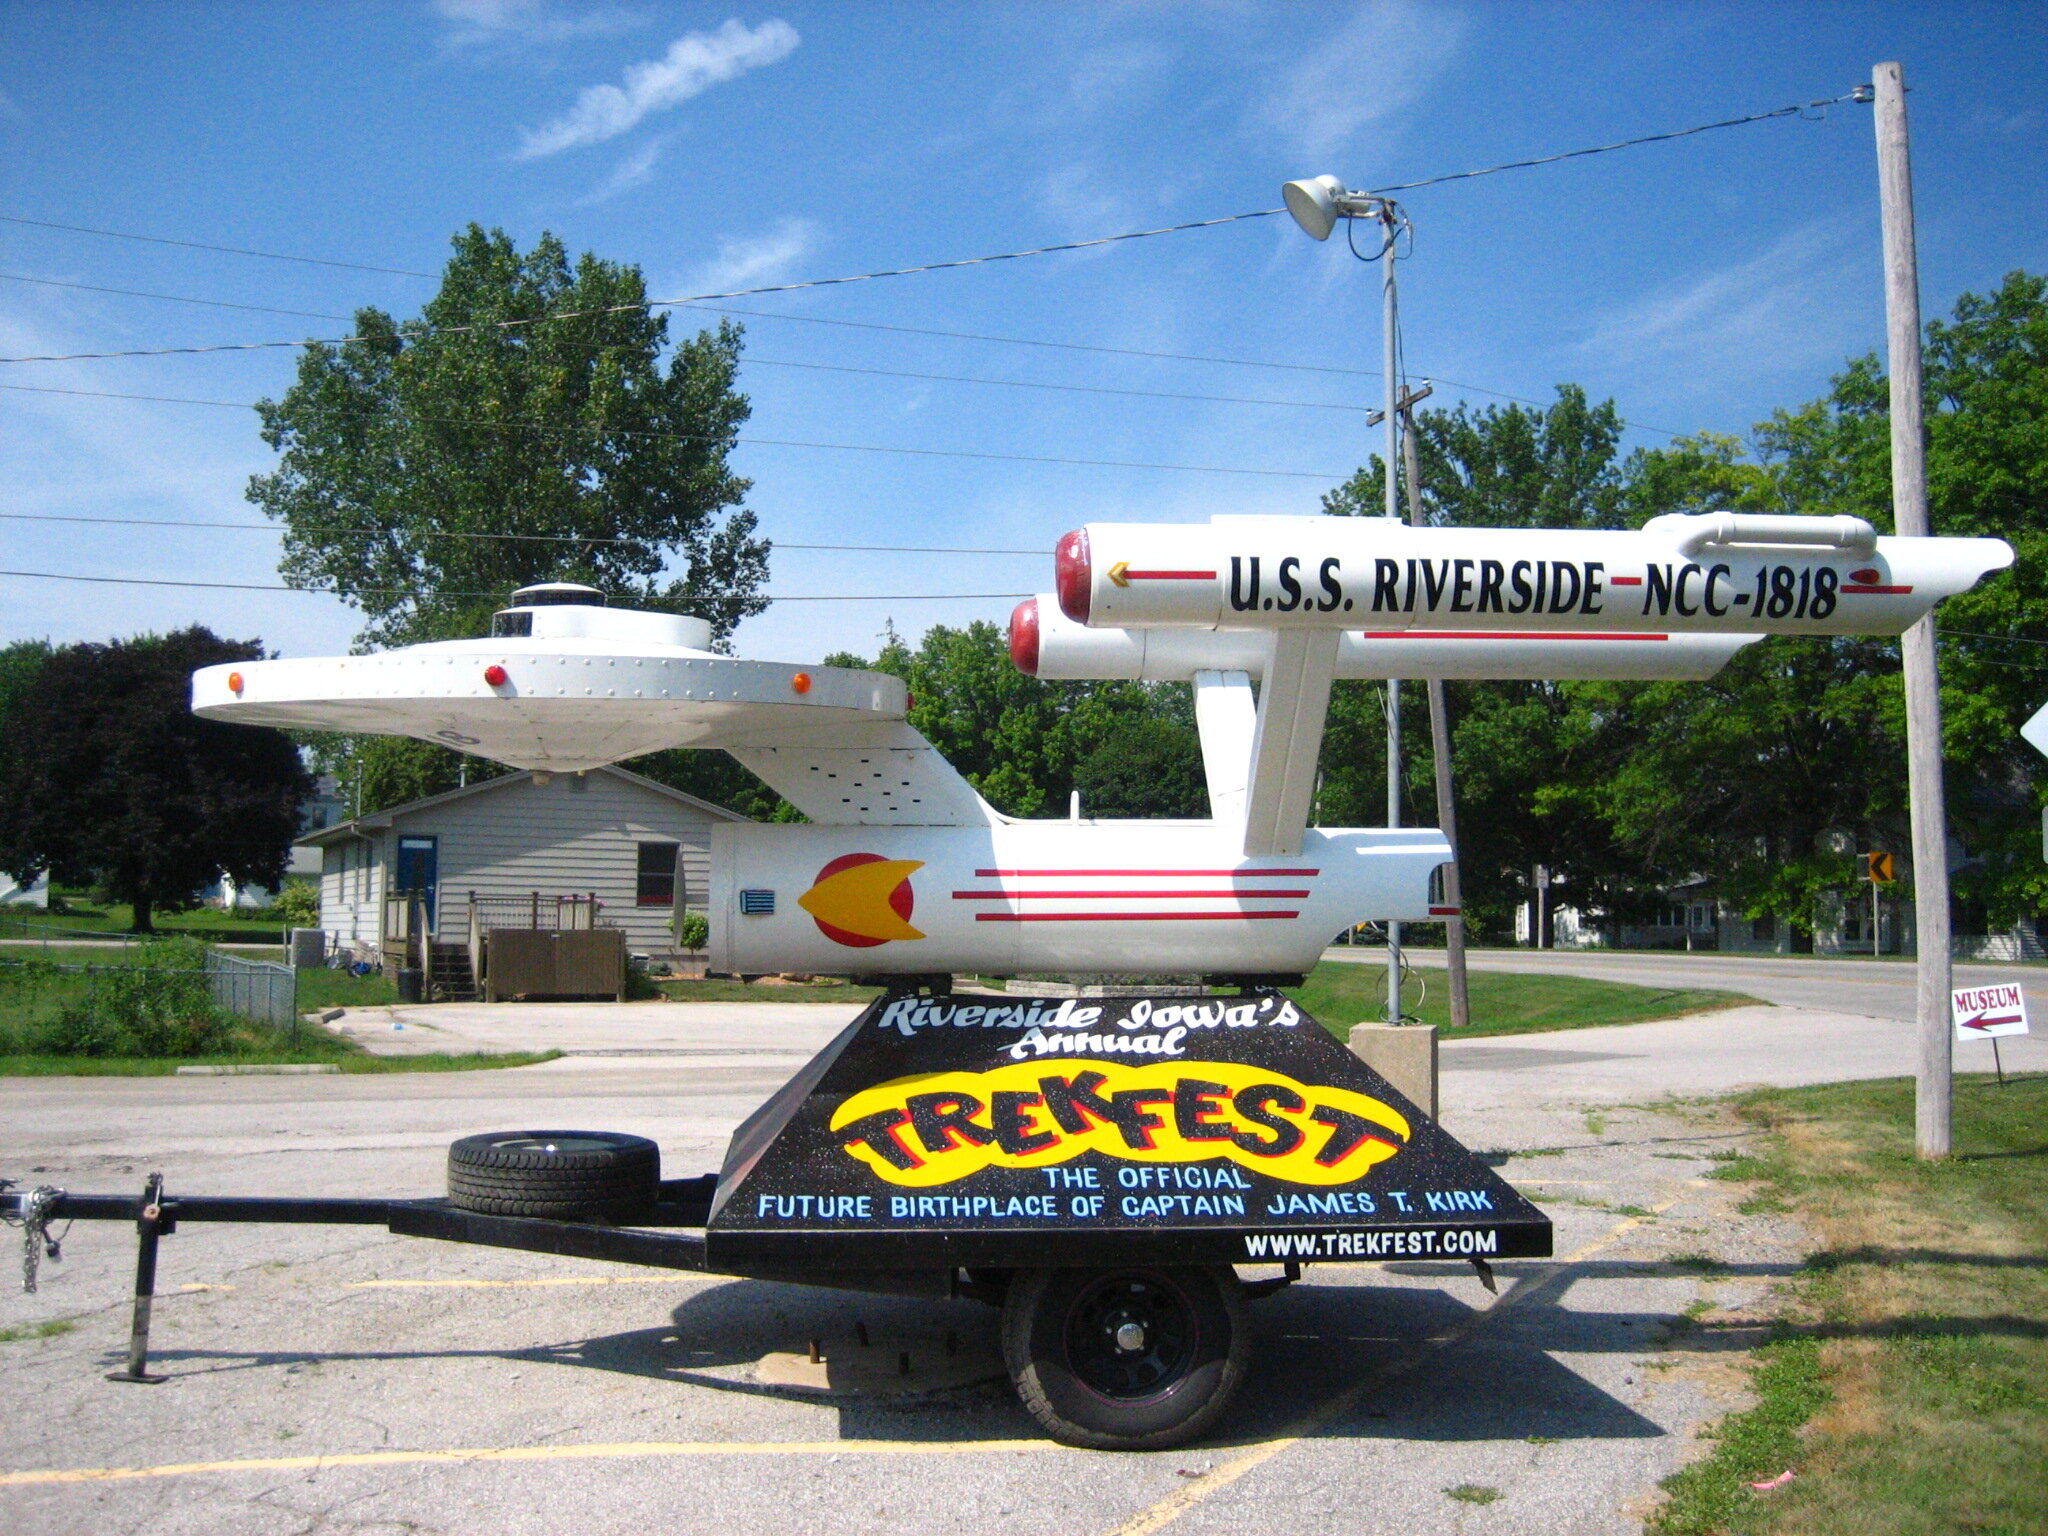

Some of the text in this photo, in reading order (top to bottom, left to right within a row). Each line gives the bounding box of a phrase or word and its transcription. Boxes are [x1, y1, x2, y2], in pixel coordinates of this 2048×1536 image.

[1230, 556, 1839, 620] U.S.S. RIVERSIDE NCC-1818
[1954, 986, 2021, 1013] MUSEUM
[878, 997, 1300, 1036] Riverside Iowa's
[998, 1026, 1187, 1060] Annual
[841, 1070, 1404, 1172] TREKFEST
[1042, 1167, 1251, 1190] THE OFFICIAL
[758, 1190, 1493, 1219] FUTURE BIRTHPLACE OF CAPTAIN JAMES T. KIRK
[1244, 1230, 1497, 1257] WWW.TREKFEST.COM
